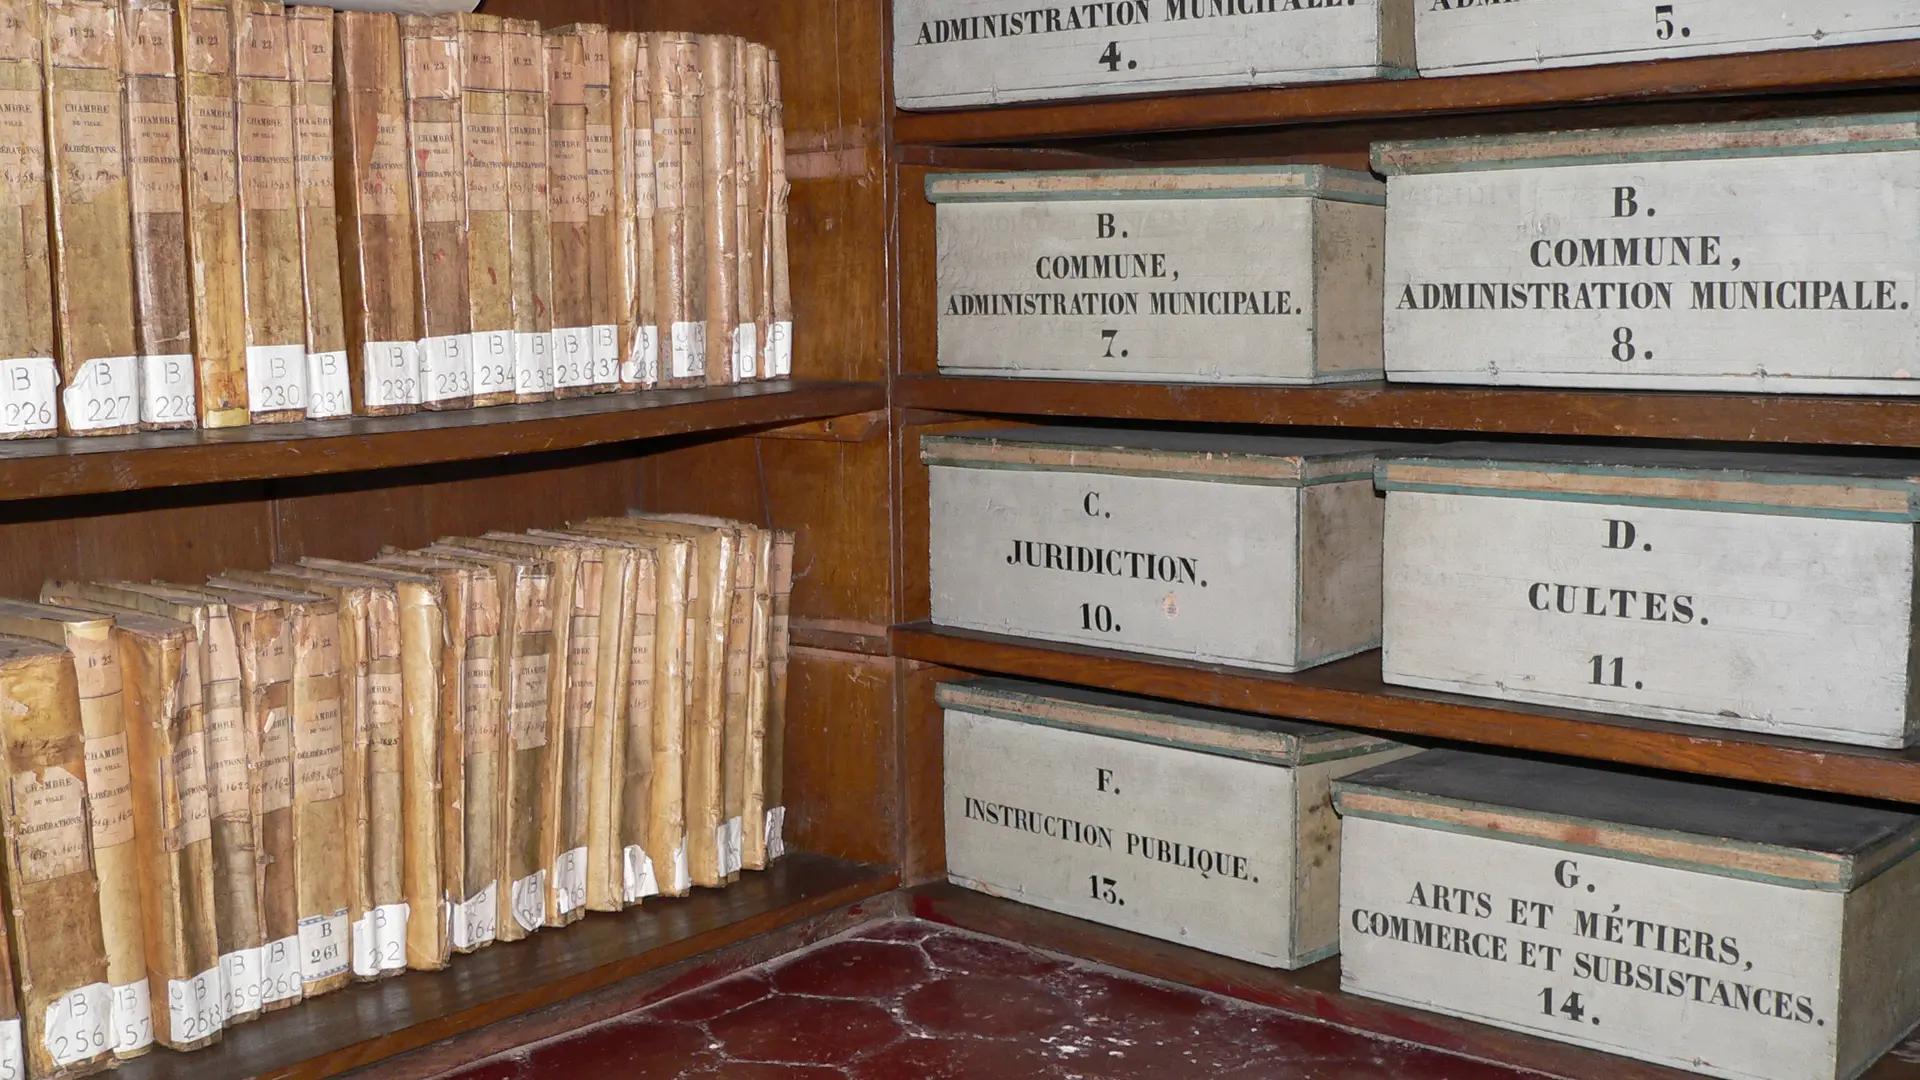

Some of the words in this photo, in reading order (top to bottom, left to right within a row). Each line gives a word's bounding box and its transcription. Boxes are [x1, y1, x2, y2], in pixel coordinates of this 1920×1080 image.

[915, 1, 1149, 45] ADMINISTRATION
[1655, 5, 1691, 40] 5.
[1098, 41, 1137, 72] 4.
[65, 104, 109, 113] CHAMBRE
[467, 124, 500, 133] CHAMBRE
[510, 126, 542, 136] CHAMBRE
[1612, 185, 1656, 218] B.
[1096, 213, 1129, 239] B.
[1530, 236, 1742, 271] COMMUNE,
[1036, 253, 1180, 281] COMMUNE,
[944, 292, 1138, 317] ADMINISTRATION
[1149, 290, 1302, 316] MUNICIPALE.
[1398, 281, 1673, 311] ADMINISTRATION
[1691, 280, 1910, 311] MUNICIPALE.
[443, 338, 459, 358] B
[488, 334, 504, 355] B
[531, 335, 545, 355] B
[564, 334, 579, 354] B
[598, 327, 613, 347] B
[1101, 330, 1129, 358] 7.
[1611, 326, 1654, 363] 8.
[270, 357, 287, 378] B
[320, 354, 338, 375] B
[389, 346, 405, 367] B
[10, 366, 32, 391] B
[94, 362, 113, 386] B
[164, 362, 182, 384] B
[436, 370, 470, 394] 233
[261, 384, 300, 407] 230
[310, 390, 346, 414] 231
[382, 377, 416, 401] 232
[5, 401, 52, 426] 226
[88, 395, 131, 421] 227
[1083, 491, 1111, 519] C.
[1601, 518, 1652, 552] D.
[1006, 539, 1208, 588] JURIDICTION.
[1528, 582, 1709, 626] CULTES.
[1079, 602, 1121, 633] 10.
[1588, 654, 1643, 690] 11.
[1096, 767, 1121, 795] F.
[964, 796, 1114, 850] INSTRUCTION
[1126, 831, 1260, 884] PUBLIQUE.
[1554, 859, 1597, 894] G.
[1088, 874, 1126, 907] 13.
[320, 922, 333, 939] B
[467, 918, 496, 943] 264
[1407, 881, 1492, 919] ARTS
[1506, 897, 1554, 931] ET
[1572, 903, 1754, 972] MÉTIERS,
[270, 941, 285, 963] B
[311, 943, 340, 964] 261
[228, 955, 246, 977] B
[1351, 908, 1508, 963] COMMERCE
[1519, 940, 1562, 973] ET
[1572, 951, 1826, 1028] SUBSISTANCES.
[194, 977, 207, 1000] B
[261, 970, 301, 1000] 260
[68, 993, 89, 1019] B
[118, 986, 138, 1012] B
[1536, 986, 1601, 1026] 14.
[55, 1024, 105, 1061] 256
